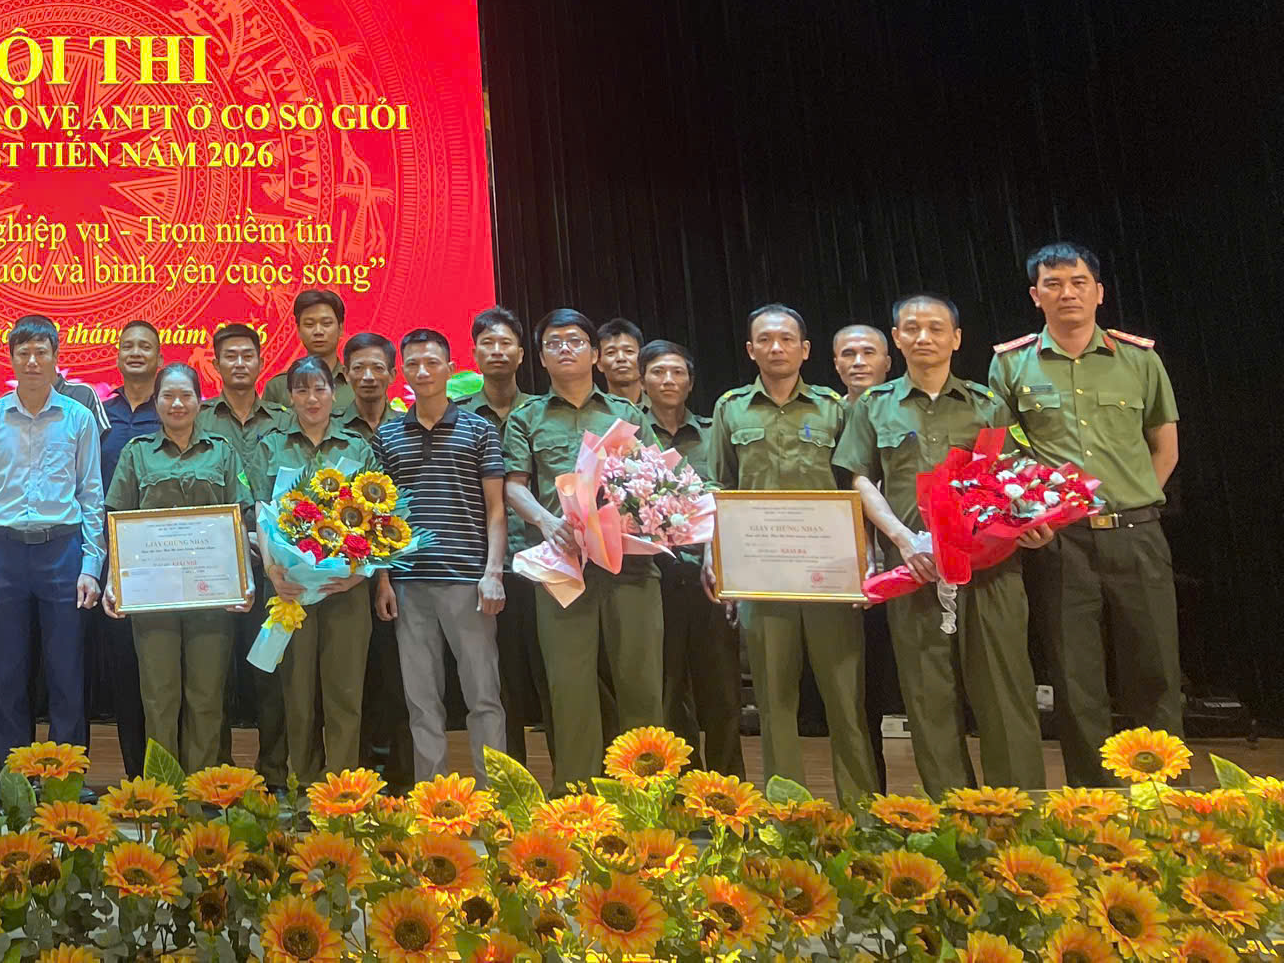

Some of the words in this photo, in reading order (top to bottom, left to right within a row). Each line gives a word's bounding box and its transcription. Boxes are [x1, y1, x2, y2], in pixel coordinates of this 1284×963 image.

[89, 35, 213, 86] THI
[36, 102, 81, 136] VỆ
[88, 104, 179, 131] ANTT
[187, 97, 214, 130] Ở
[220, 101, 271, 130] CƠ
[279, 96, 324, 130] SỞ
[331, 97, 410, 130] GIỎI
[31, 135, 109, 167] TIẾN
[119, 134, 197, 167] NĂM
[206, 141, 274, 168] 2026
[75, 223, 111, 248] vụ
[139, 215, 207, 248] Trọn
[214, 207, 287, 244] niềm
[295, 215, 333, 244] tin
[51, 256, 85, 284] và
[93, 255, 157, 284] bình
[165, 256, 217, 292] yên
[225, 256, 293, 291] cuộc
[67, 322, 123, 350] thán
[158, 324, 207, 345] năm
